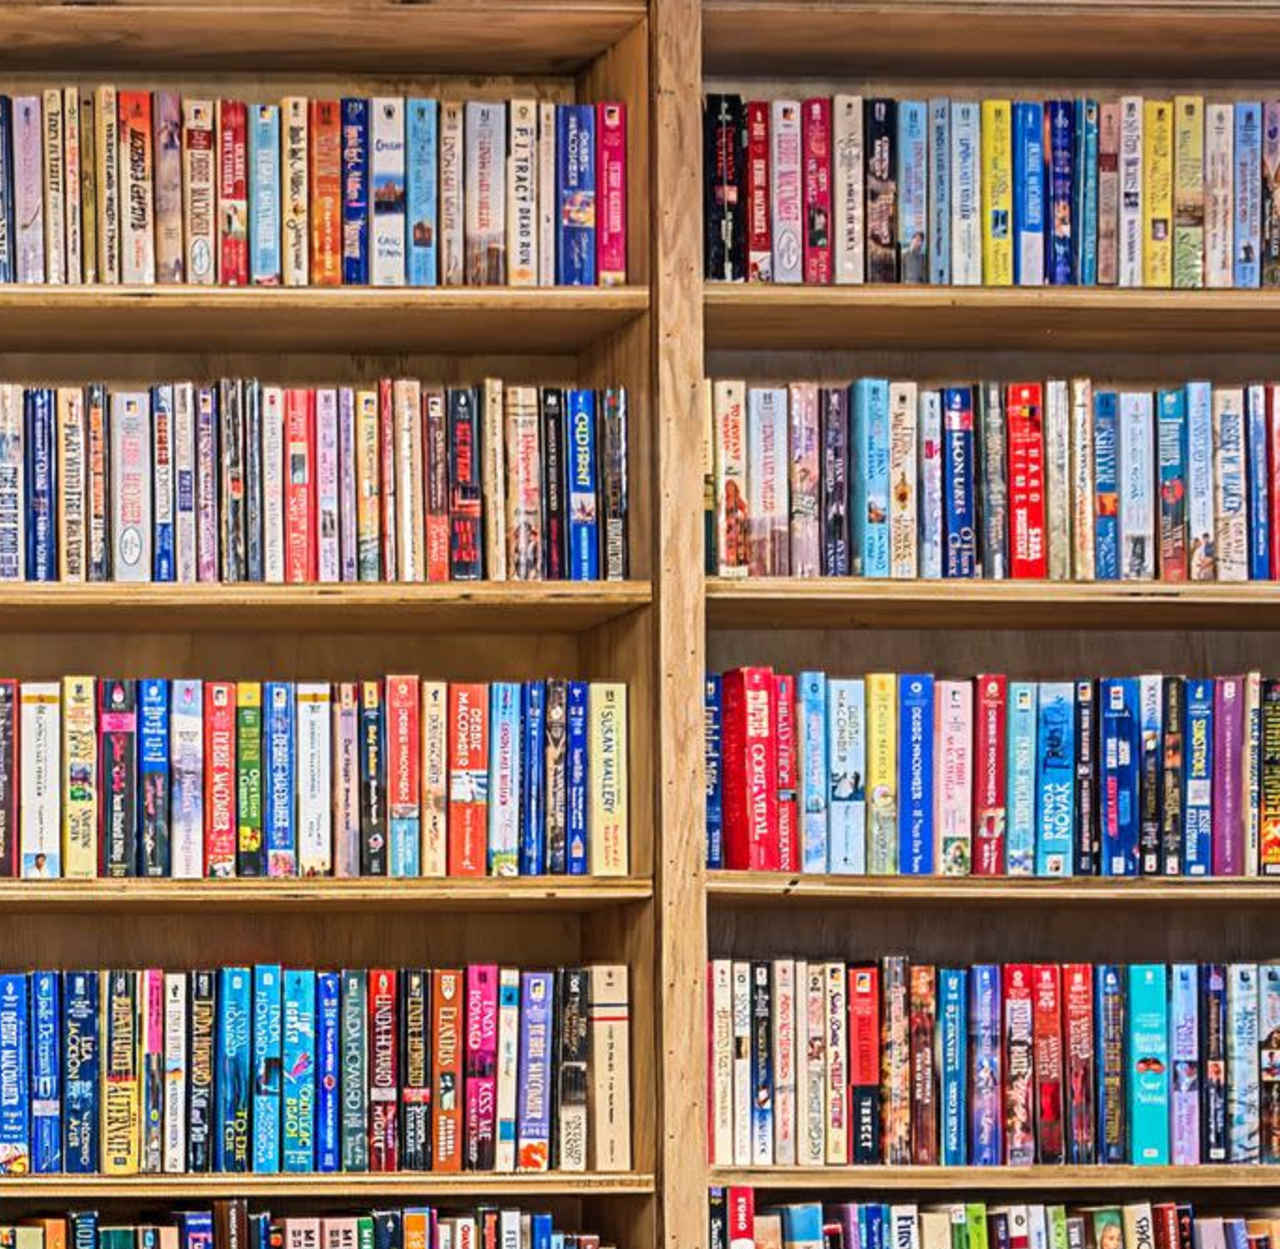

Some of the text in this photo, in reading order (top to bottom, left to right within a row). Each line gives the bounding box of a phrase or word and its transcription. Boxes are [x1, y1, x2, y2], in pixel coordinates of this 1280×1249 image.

[515, 157, 530, 202] TRACY
[600, 711, 615, 814] SUSAN MALLERY
[342, 998, 361, 1109] LINDA HOWARD
[374, 1031, 394, 1087] HOWARD
